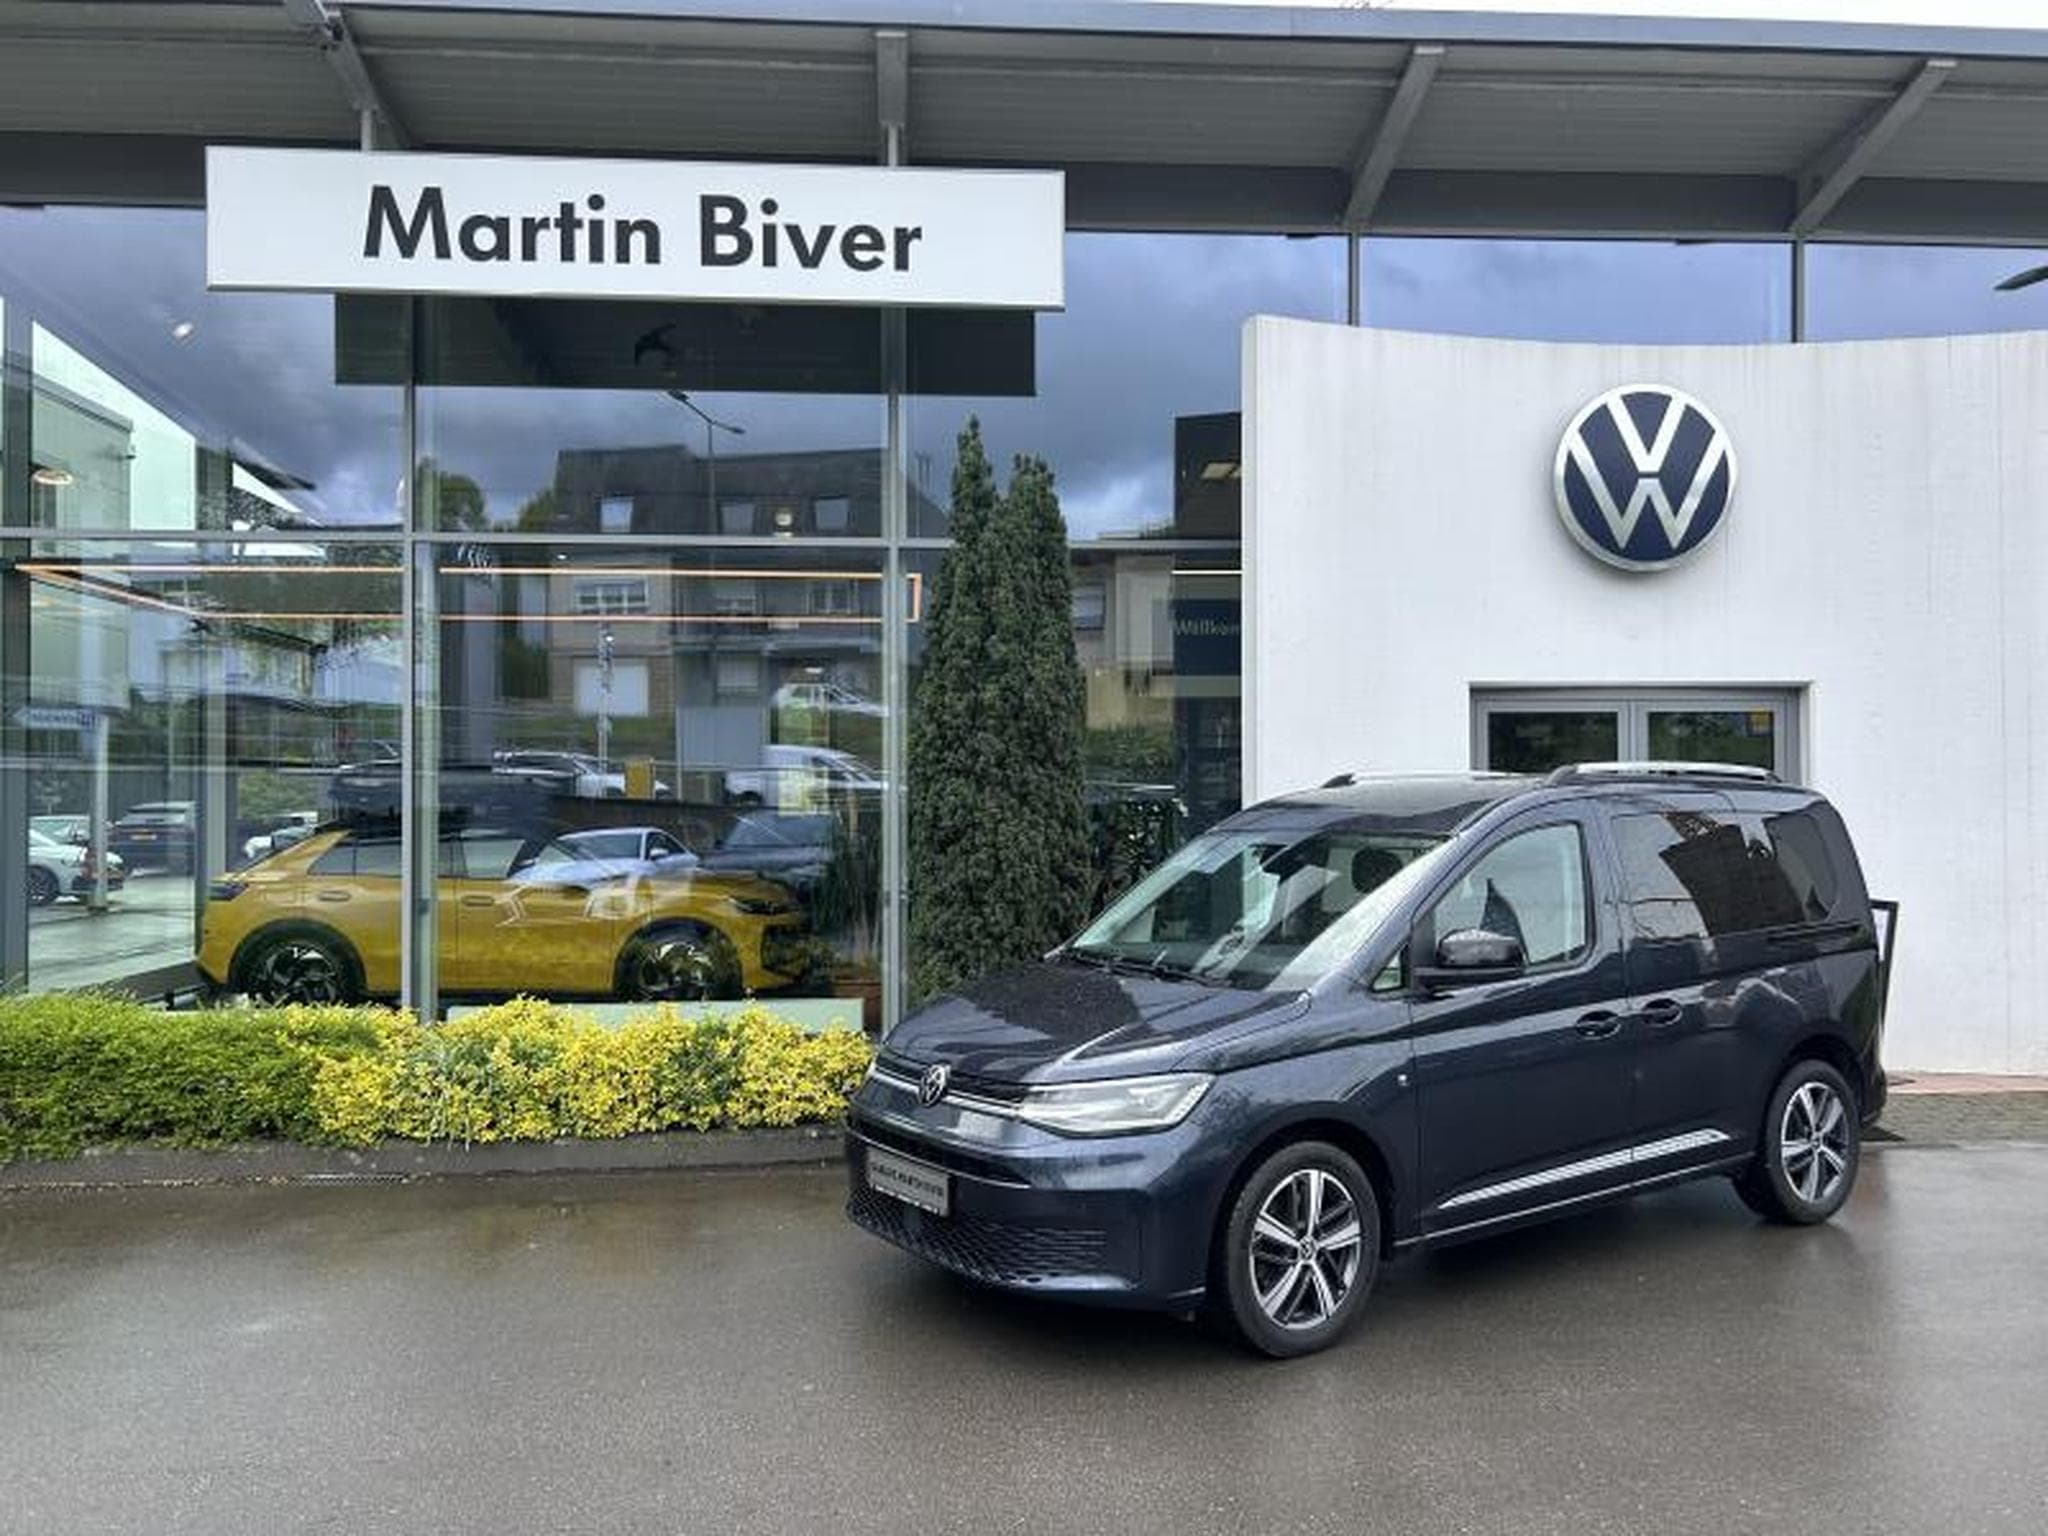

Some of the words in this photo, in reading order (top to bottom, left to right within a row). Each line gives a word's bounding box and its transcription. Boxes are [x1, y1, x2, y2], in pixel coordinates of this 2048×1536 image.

[363, 185, 661, 266] Martin
[700, 194, 922, 272] Biver
[1559, 384, 1734, 557] VW
